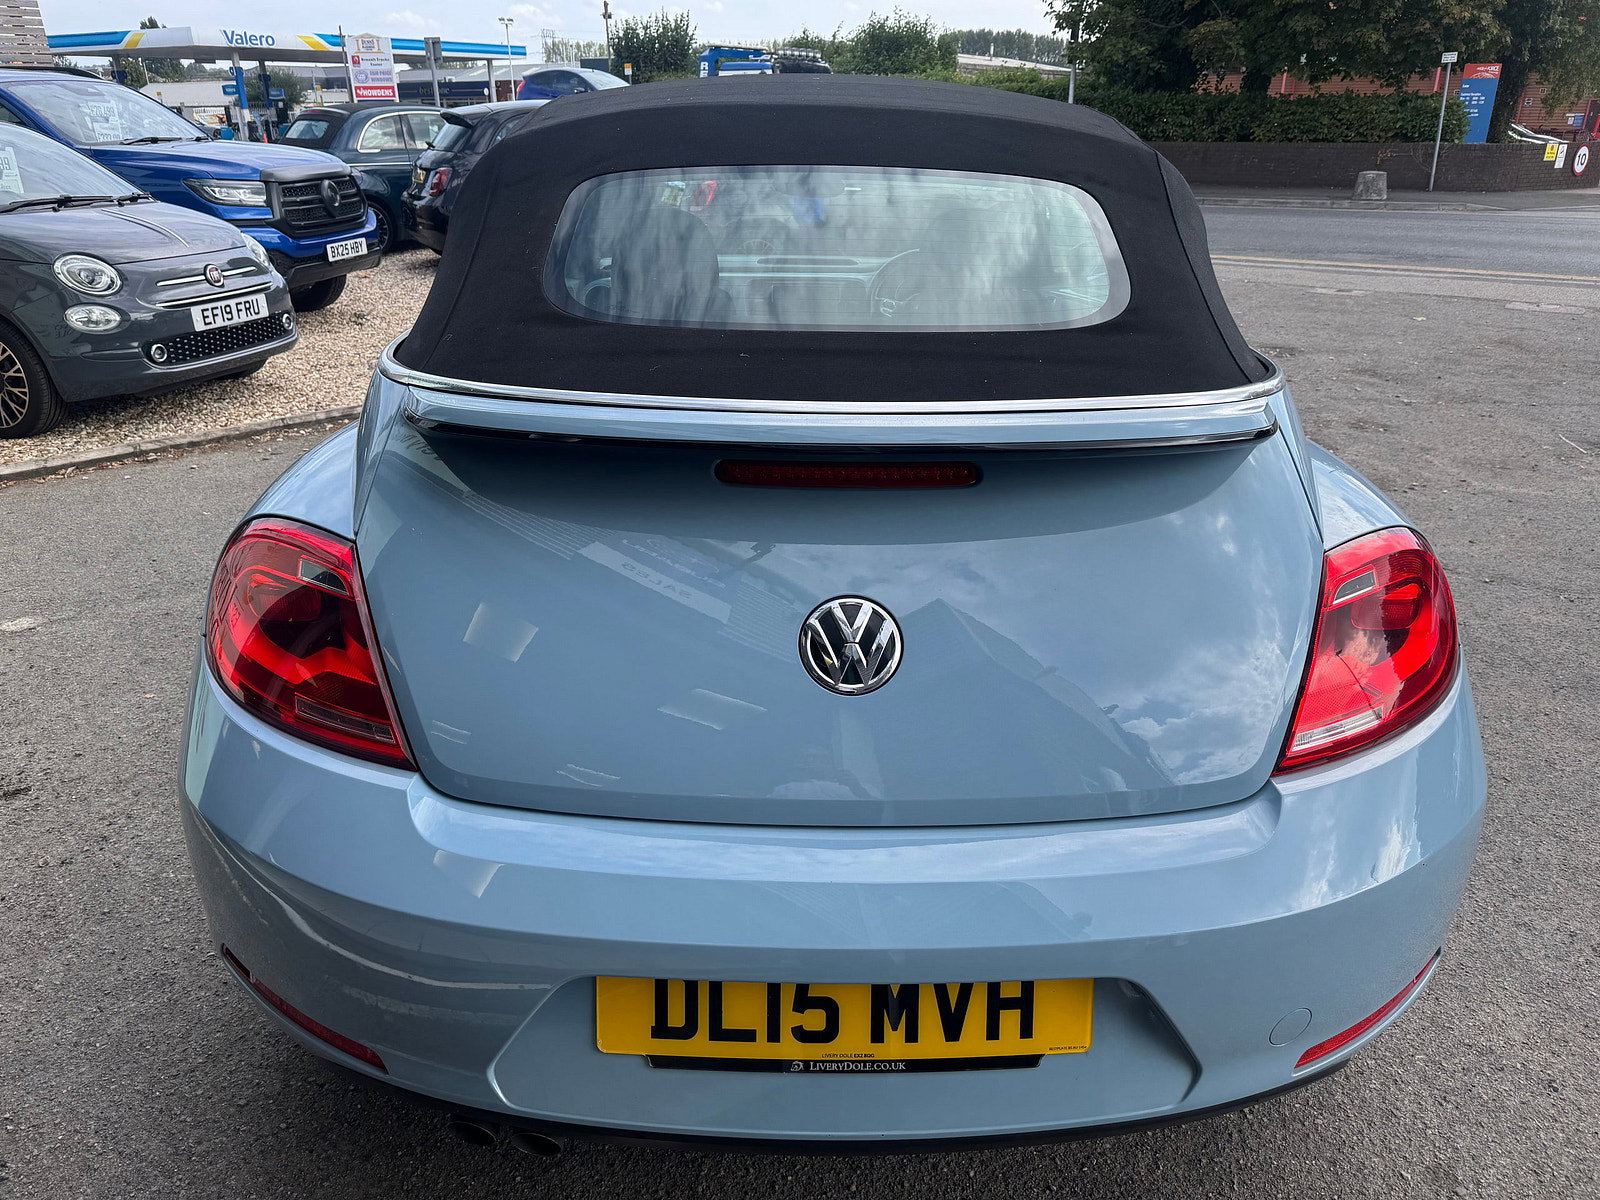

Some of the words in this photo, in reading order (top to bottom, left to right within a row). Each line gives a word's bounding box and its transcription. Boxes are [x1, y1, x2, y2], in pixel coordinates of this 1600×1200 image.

[223, 30, 275, 46] Valero
[1577, 153, 1587, 166] 10
[330, 244, 350, 258] BX25
[349, 241, 364, 255] HBY
[201, 304, 233, 326] EF19
[235, 298, 261, 318] FRU
[651, 979, 840, 1044] DL15
[870, 980, 1035, 1044] MVH
